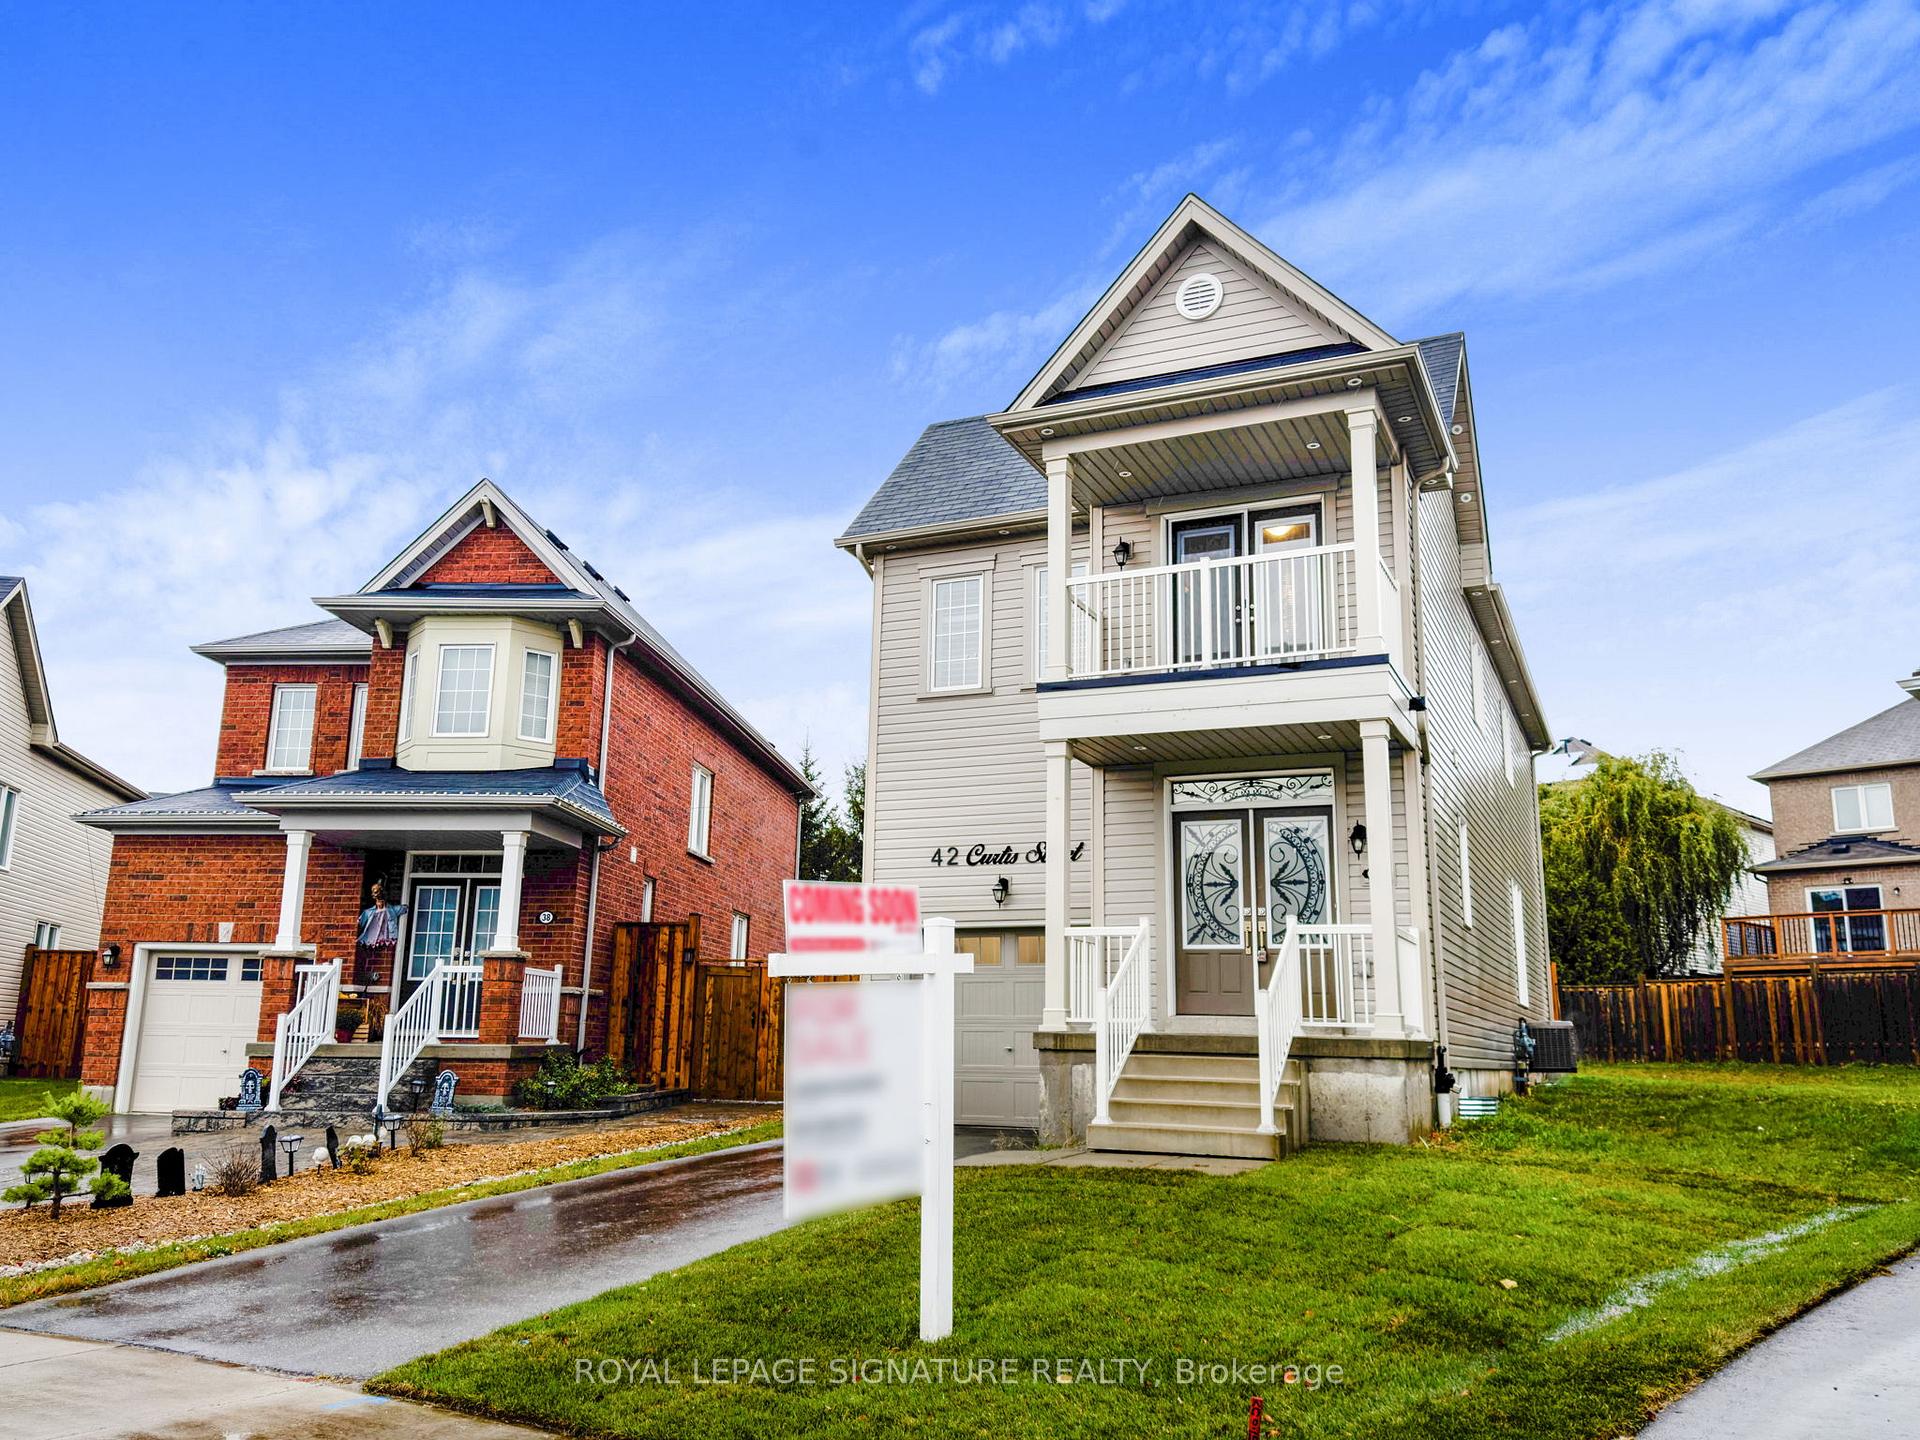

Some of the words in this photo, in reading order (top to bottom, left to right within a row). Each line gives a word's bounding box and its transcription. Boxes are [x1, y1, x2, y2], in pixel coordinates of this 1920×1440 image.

[931, 847, 958, 866] 42
[966, 844, 1019, 866] Curtis
[790, 885, 864, 924] COMING
[869, 889, 918, 925] SOON
